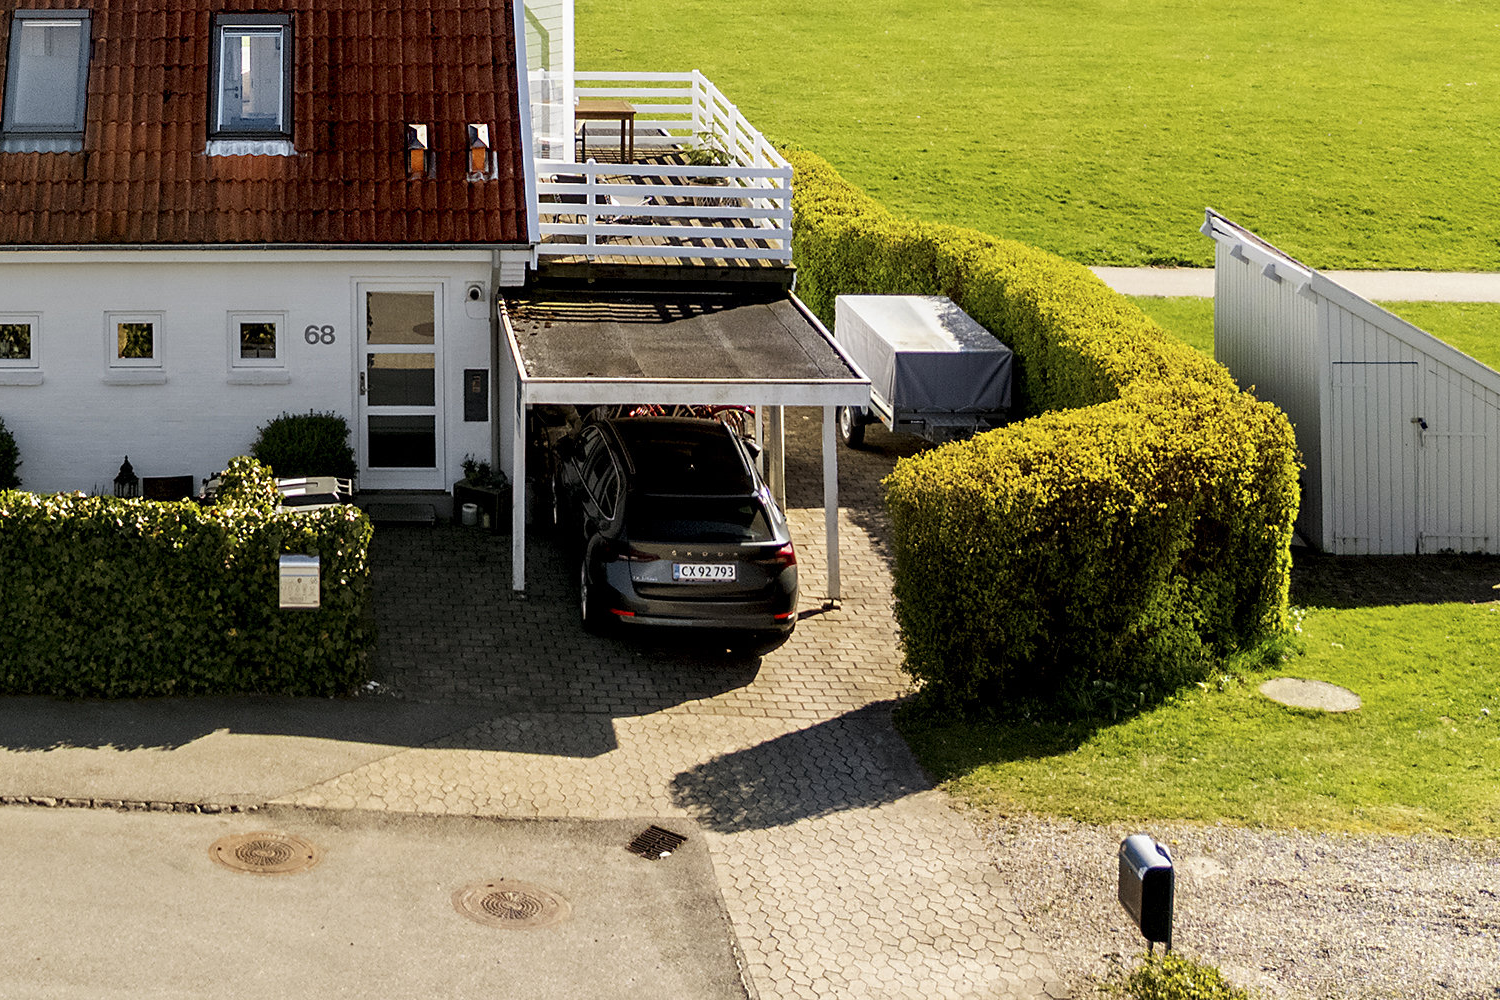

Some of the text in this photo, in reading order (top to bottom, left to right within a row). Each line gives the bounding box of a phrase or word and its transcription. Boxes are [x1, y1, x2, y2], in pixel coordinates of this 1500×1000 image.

[304, 324, 336, 345] 68
[681, 566, 734, 577] CX 92 793
